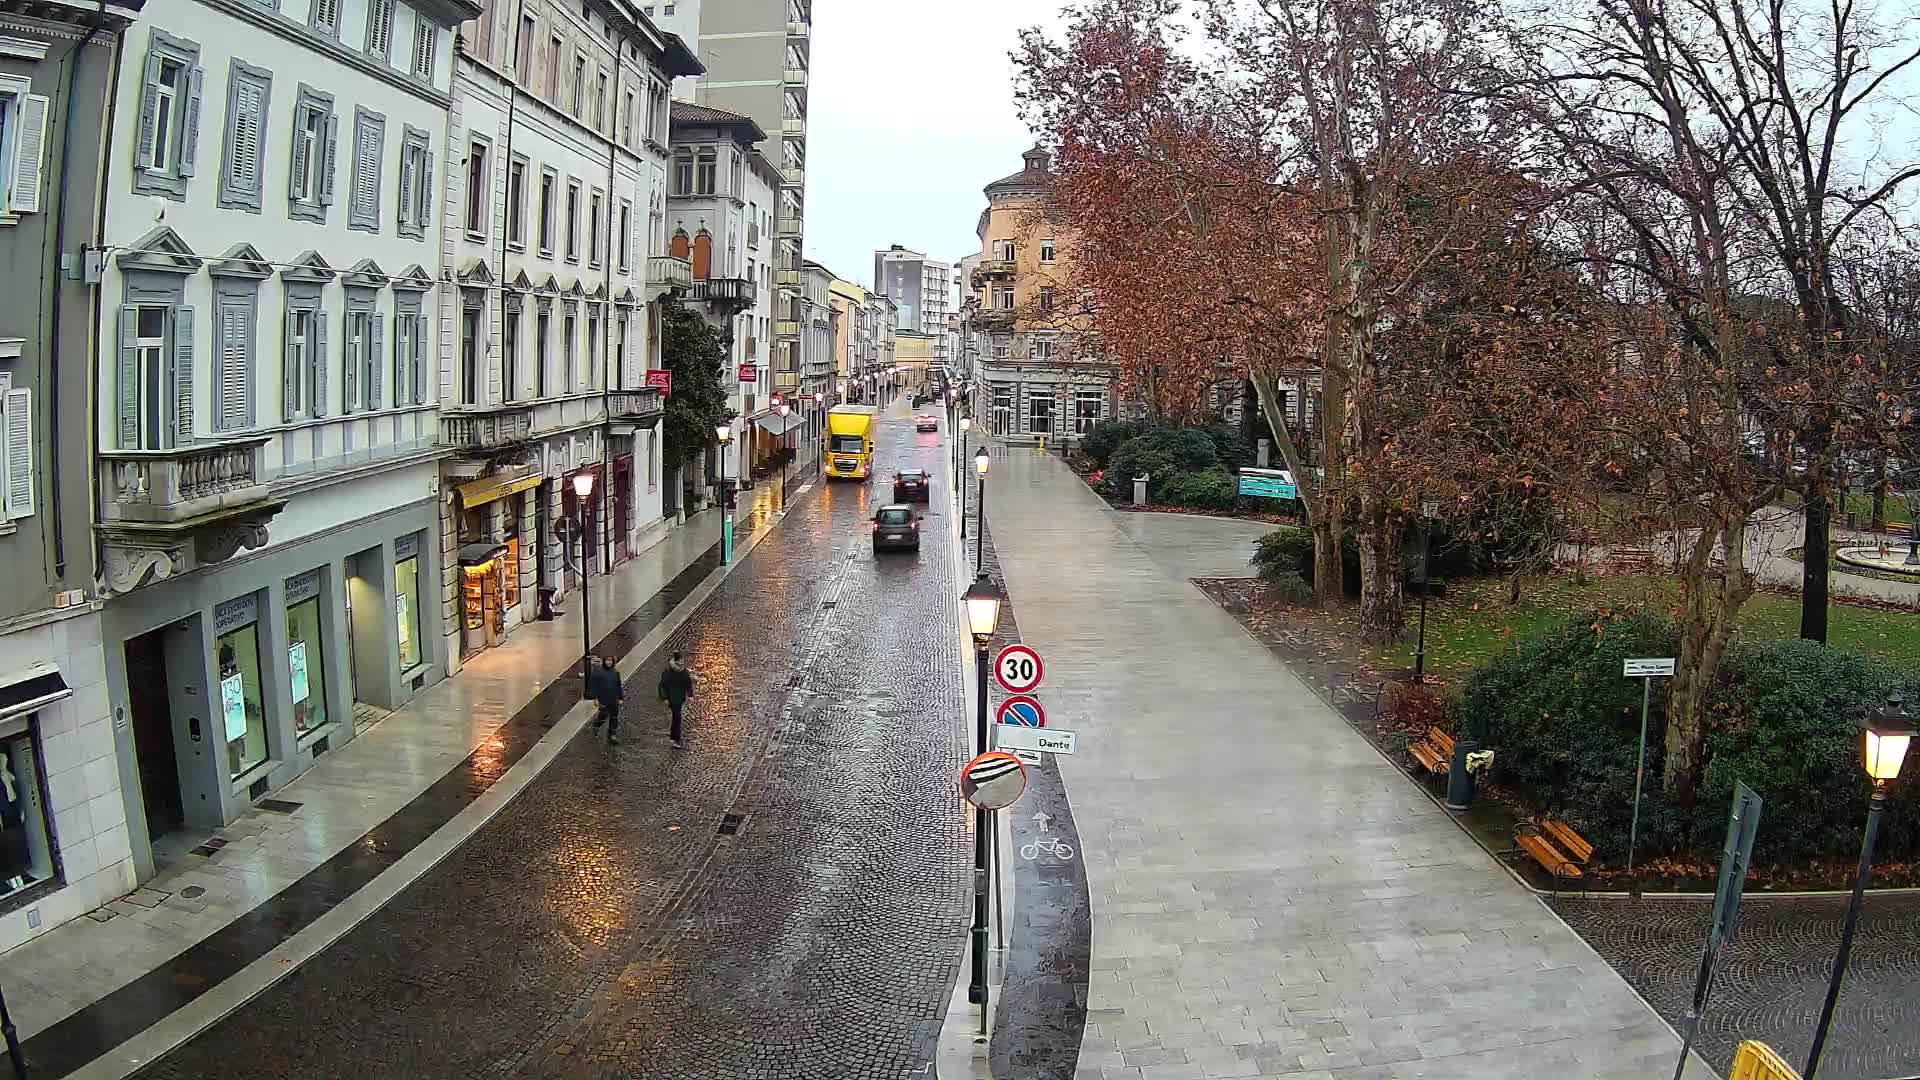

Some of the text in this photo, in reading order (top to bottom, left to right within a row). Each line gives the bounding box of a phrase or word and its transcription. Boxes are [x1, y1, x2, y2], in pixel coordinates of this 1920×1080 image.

[1006, 658, 1033, 681] 30
[223, 678, 241, 700] 130
[1039, 738, 1070, 749] Dante
